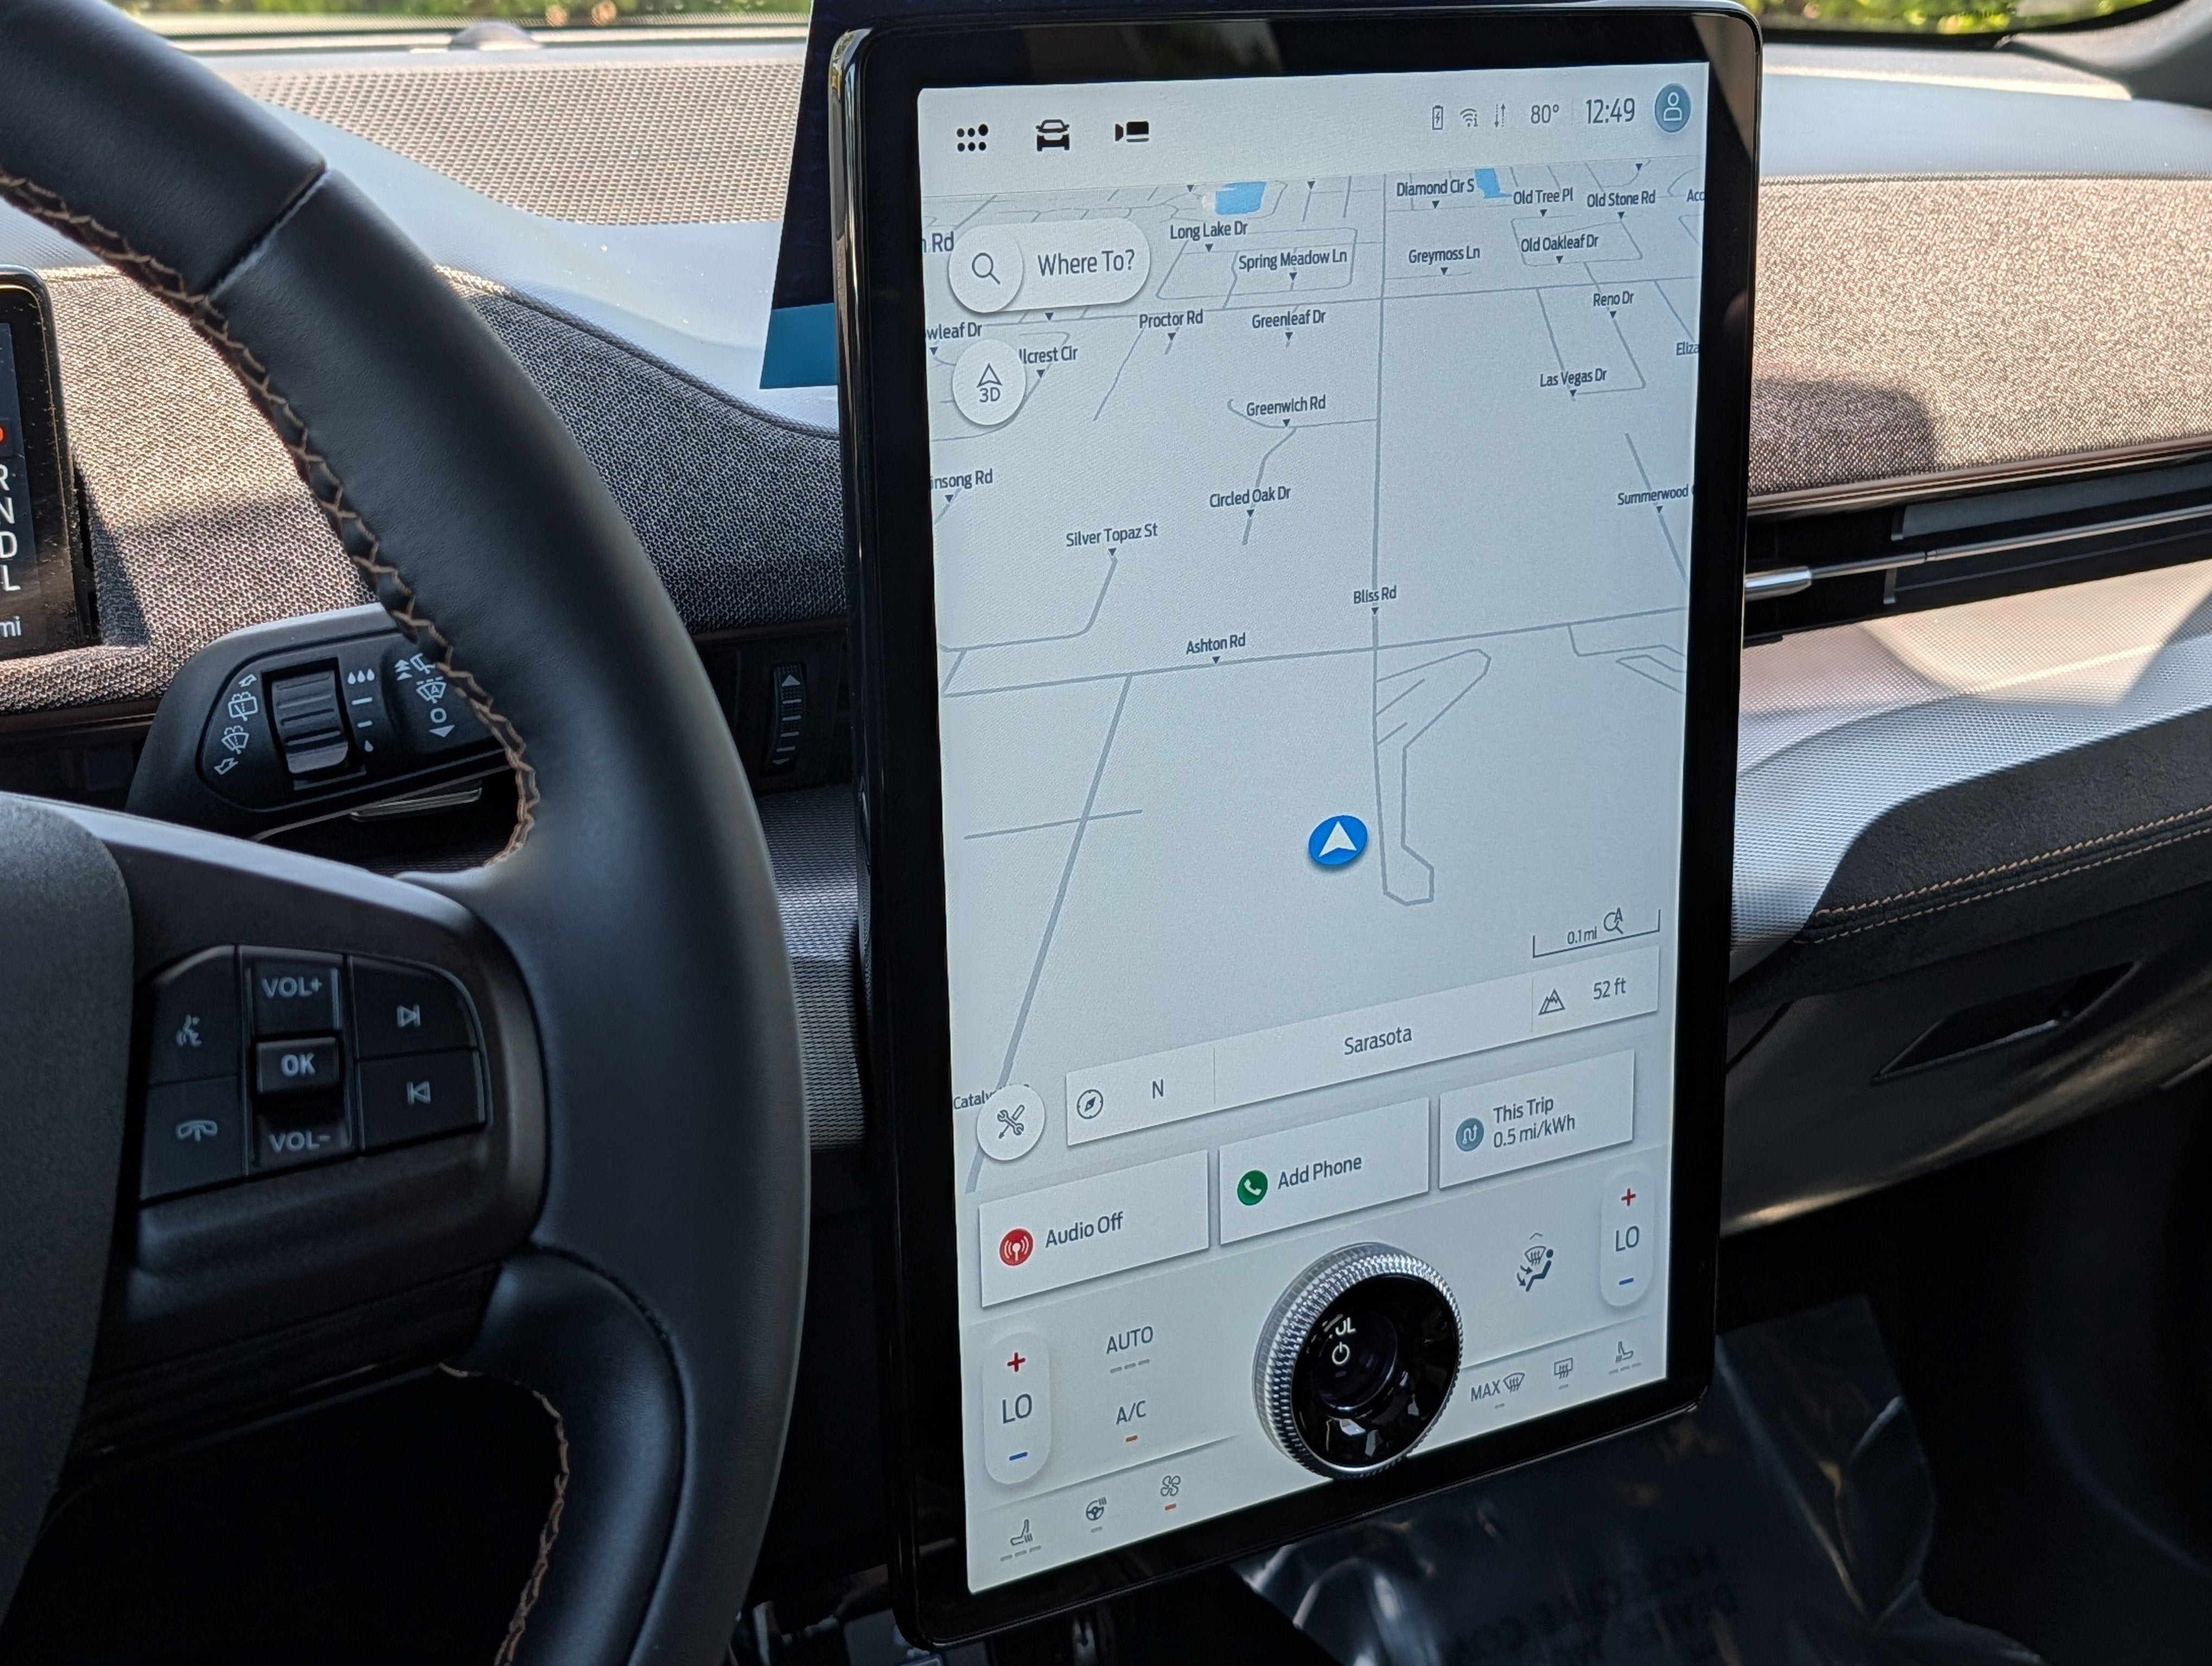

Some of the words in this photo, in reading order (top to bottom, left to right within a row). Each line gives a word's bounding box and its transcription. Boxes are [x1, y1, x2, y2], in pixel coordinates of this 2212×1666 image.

[1531, 104, 1559, 124] 80°
[1586, 98, 1635, 124] 12:49
[1397, 180, 1447, 197] Diamond
[1450, 178, 1464, 193] Cir
[1466, 178, 1474, 191] S
[1513, 190, 1533, 204] Old
[1535, 189, 1560, 203] Tree
[1562, 188, 1573, 201] Pl
[1587, 193, 1606, 208] Old
[1608, 191, 1638, 206] Stone
[1641, 190, 1655, 204] Rd
[932, 230, 954, 253] Rd
[1170, 224, 1200, 241] Long
[1202, 222, 1232, 238] Lake
[1234, 221, 1248, 236] Dr
[1409, 247, 1464, 264] Greymoss
[1466, 246, 1480, 260] Ln
[1521, 238, 1540, 253] Old
[1542, 235, 1585, 251] Oakleaf
[1586, 235, 1599, 248] Dr
[1038, 253, 1097, 277] Where
[1102, 249, 1135, 272] To?
[1238, 254, 1278, 272] Spring
[1279, 252, 1328, 270] Meadow
[1332, 249, 1347, 263] Ln
[1593, 293, 1620, 306] Reno
[1622, 291, 1634, 305] Dr
[1139, 312, 1184, 328] Proctor
[1186, 309, 1203, 324] Rd
[1251, 312, 1310, 329] Greenleaf
[1311, 310, 1326, 324] Dr
[926, 322, 965, 340] wleaf
[968, 322, 982, 337] Dr
[1062, 345, 1078, 361] Cir
[1540, 373, 1558, 387] Las
[1560, 370, 1592, 387] Vegas
[1594, 368, 1607, 382] Dr
[979, 388, 1000, 403] 3D
[1247, 399, 1307, 416] Greenwich
[1310, 396, 1326, 411] Rd
[975, 468, 993, 485] Rd
[1210, 491, 1249, 508] Circled
[1252, 488, 1275, 503] Oak
[1278, 486, 1290, 500] Dr
[1617, 484, 1688, 505] Summerwood
[0, 531, 17, 559] D
[1066, 530, 1101, 547] Silver
[1104, 527, 1141, 544] Topaz
[1144, 523, 1158, 538] St
[2, 565, 21, 591] L
[1353, 589, 1379, 604] Bliss
[1381, 586, 1397, 600] Rd
[1186, 637, 1226, 655] Ashton
[1229, 633, 1245, 648] Rd
[1594, 981, 1611, 1000] 52
[1613, 977, 1625, 996] ft
[1345, 1027, 1412, 1055] Sarasota
[281, 1053, 316, 1077] OK
[1152, 1079, 1164, 1099] N
[1494, 1101, 1523, 1124] This
[1526, 1097, 1554, 1117] Trip
[1494, 1127, 1516, 1148] 0.5
[1519, 1114, 1575, 1142] mi/kWh
[1277, 1165, 1309, 1189] Add
[1313, 1156, 1361, 1180] Phone
[1045, 1219, 1094, 1248] Audio
[1097, 1211, 1123, 1234] Off
[1616, 1225, 1639, 1253] LO
[1106, 1327, 1153, 1354] AUTO
[1470, 1379, 1501, 1401] MAX
[1002, 1394, 1033, 1424] LO
[1116, 1401, 1147, 1424] A/C
